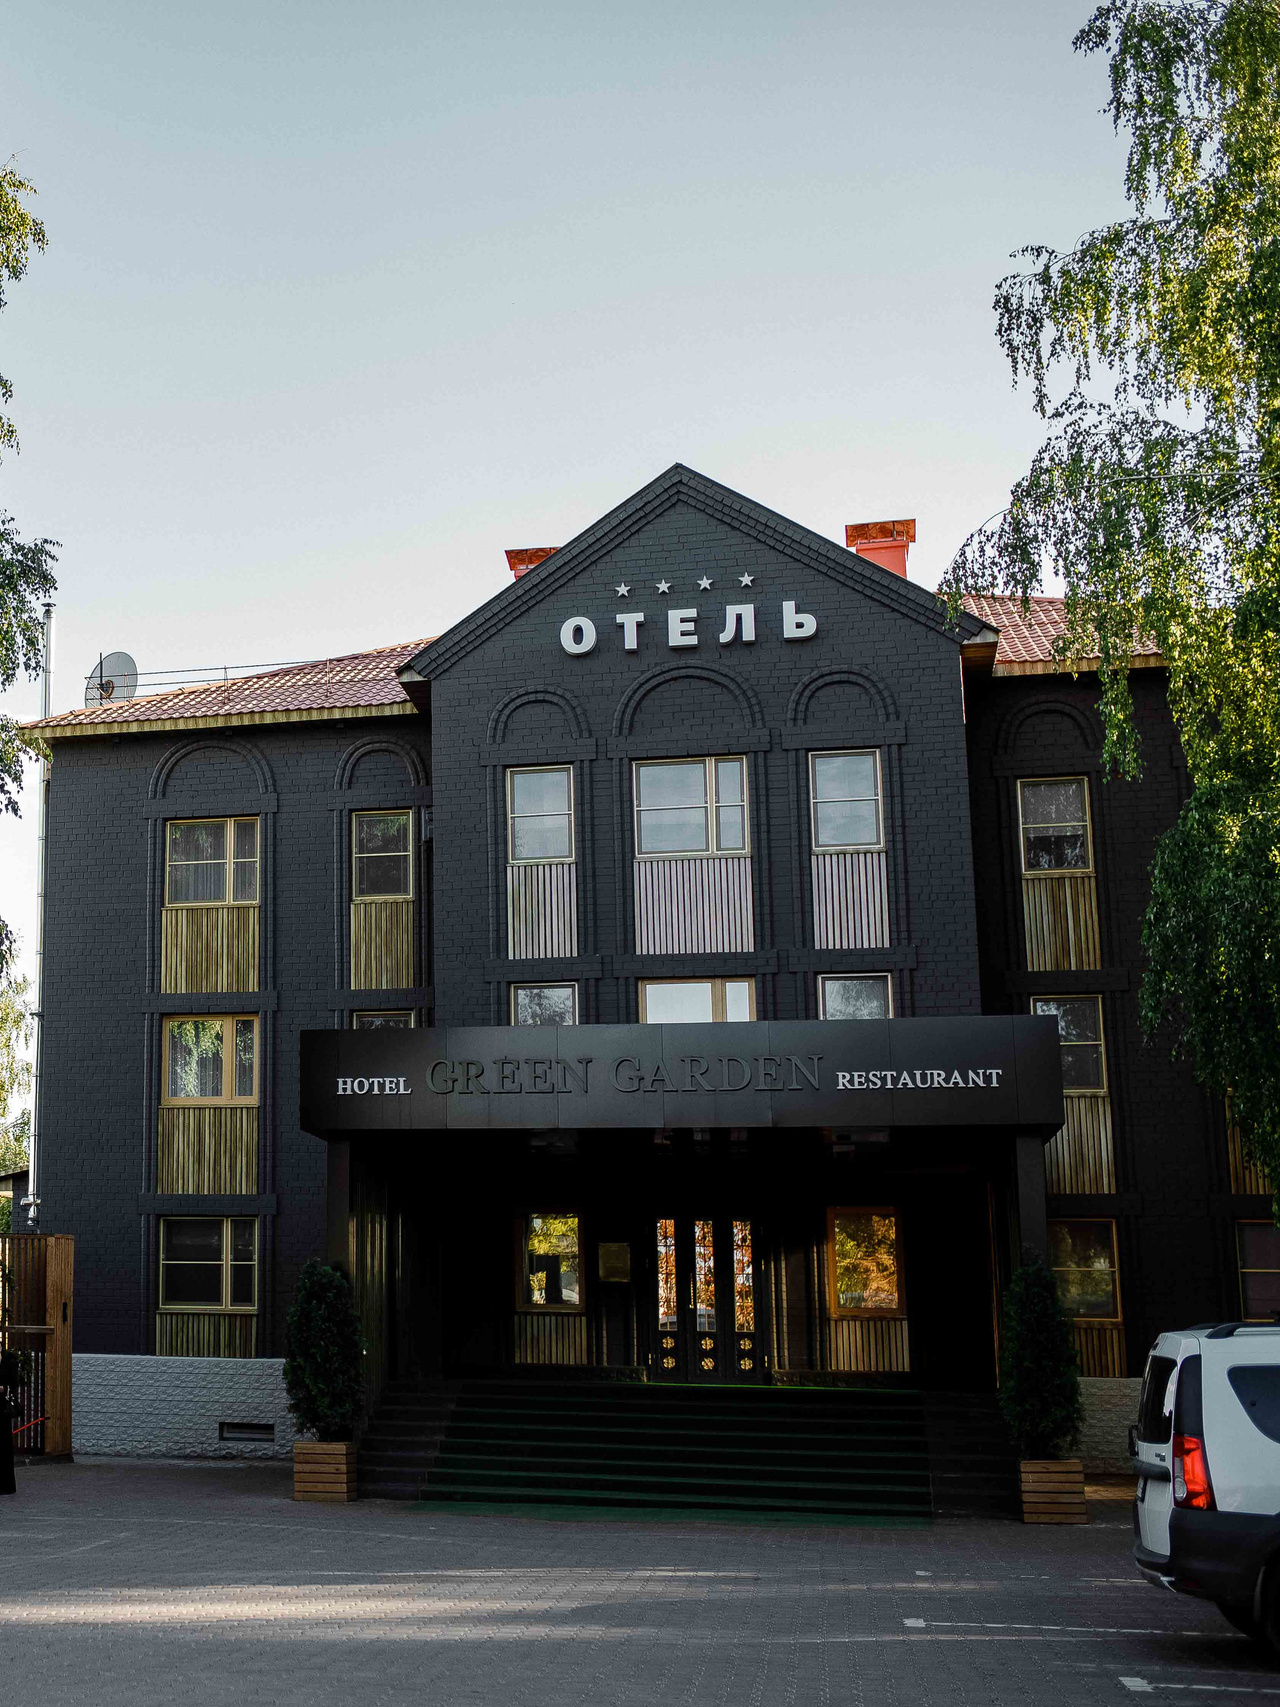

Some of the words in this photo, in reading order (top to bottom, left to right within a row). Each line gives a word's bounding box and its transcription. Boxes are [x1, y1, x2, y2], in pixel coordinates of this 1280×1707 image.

[559, 600, 818, 656] ОТЕЛЬ
[336, 1077, 413, 1096] HOTEL
[425, 1057, 595, 1095] GREEN
[609, 1054, 823, 1093] GARDEN
[835, 1069, 1003, 1091] RESTAURANT
